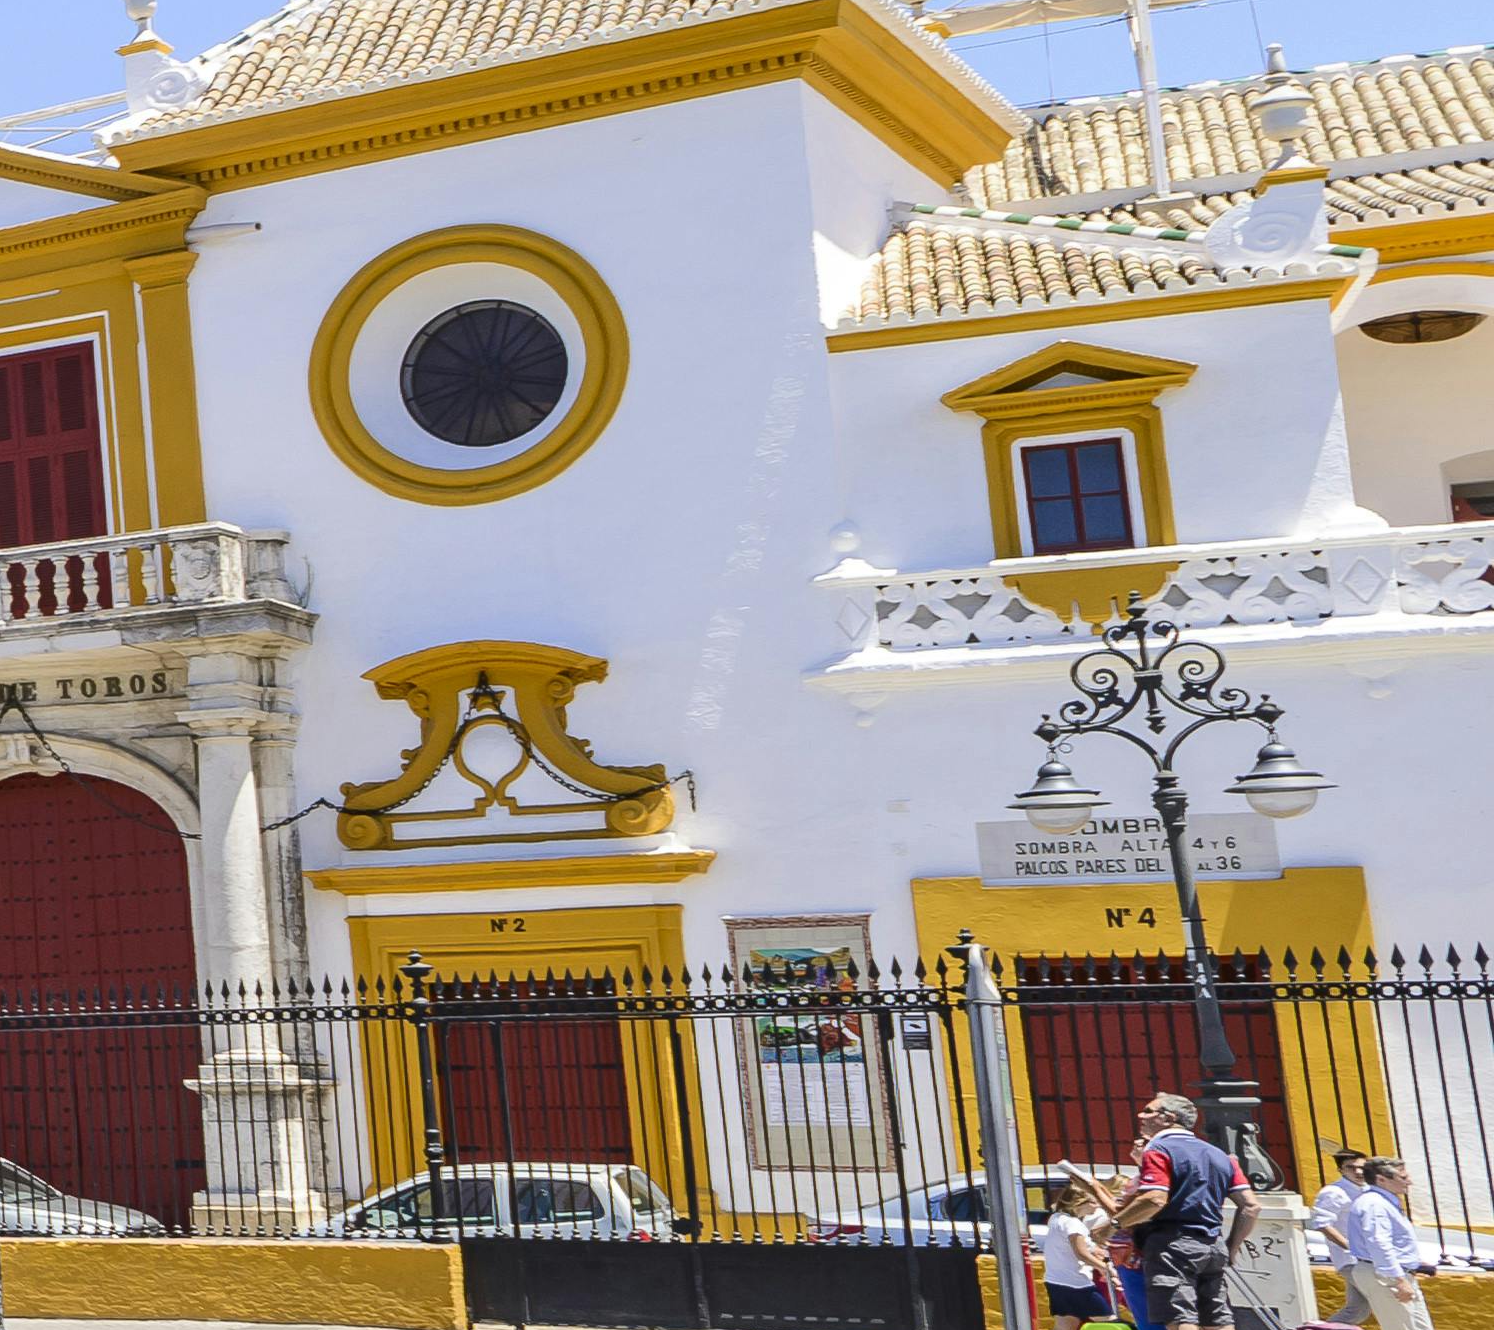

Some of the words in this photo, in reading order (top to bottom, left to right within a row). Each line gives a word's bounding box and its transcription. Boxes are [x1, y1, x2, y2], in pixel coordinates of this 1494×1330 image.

[56, 672, 168, 700] TOROS
[1070, 817, 1167, 836] OMBR
[1015, 841, 1098, 855] SOMBRA
[1191, 837, 1204, 850] 4
[1225, 836, 1237, 850] 6
[1015, 859, 1068, 876] PALCOS
[1075, 858, 1127, 874] PARES
[1135, 857, 1166, 873] DEL
[1215, 855, 1242, 871] 36
[513, 917, 527, 933] 2
[1137, 907, 1157, 928] 4
